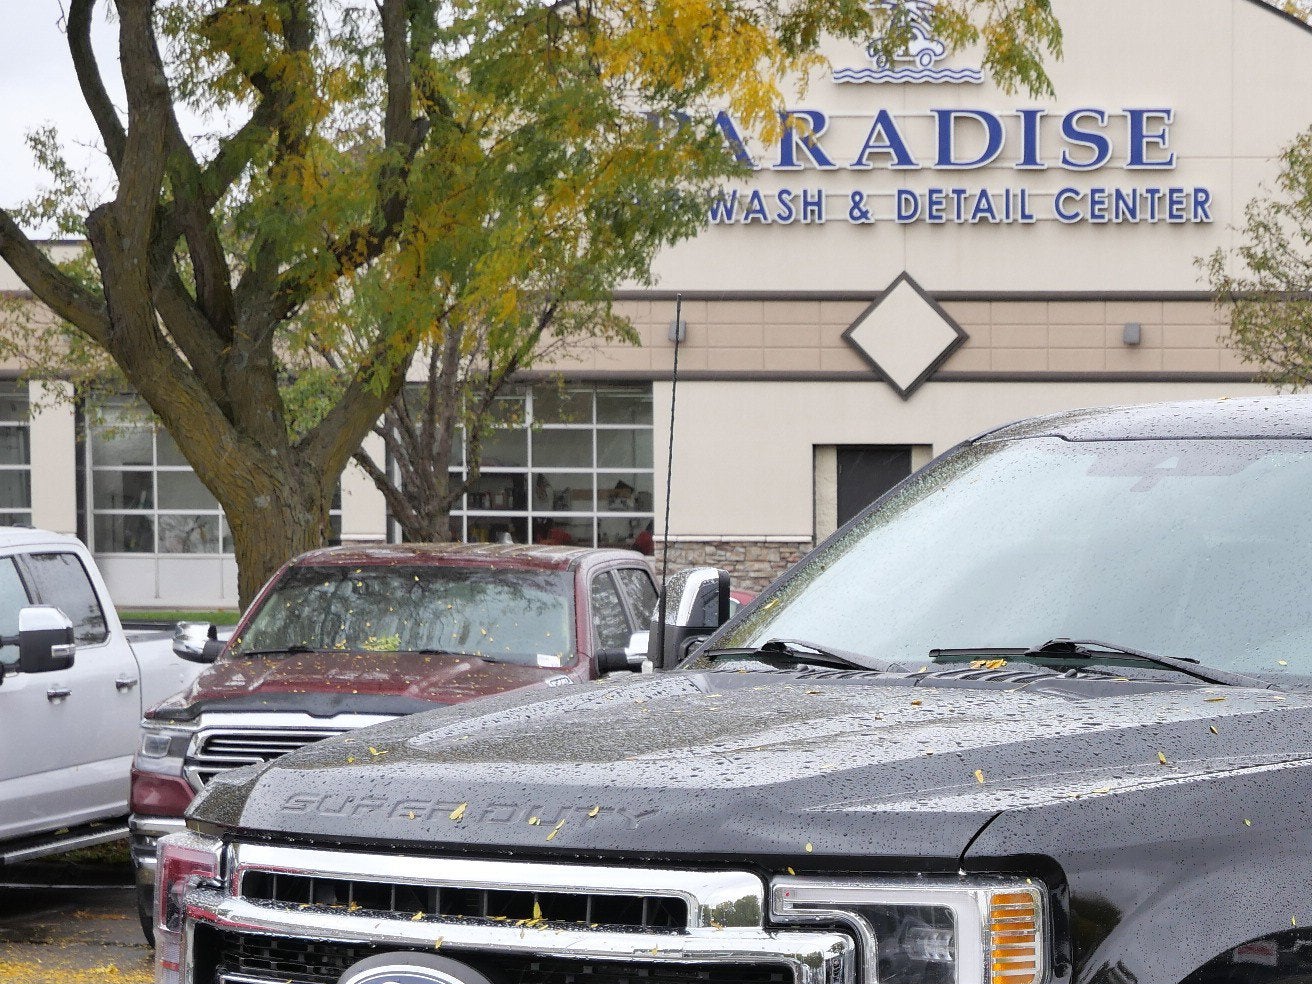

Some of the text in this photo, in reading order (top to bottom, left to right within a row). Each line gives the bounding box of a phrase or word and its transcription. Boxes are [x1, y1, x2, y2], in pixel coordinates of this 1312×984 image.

[709, 188, 824, 223] WASH
[849, 189, 872, 222] &
[897, 188, 1035, 223] DETAIL
[1055, 187, 1213, 223] CENTER
[282, 791, 661, 830] SUPER DUTY
